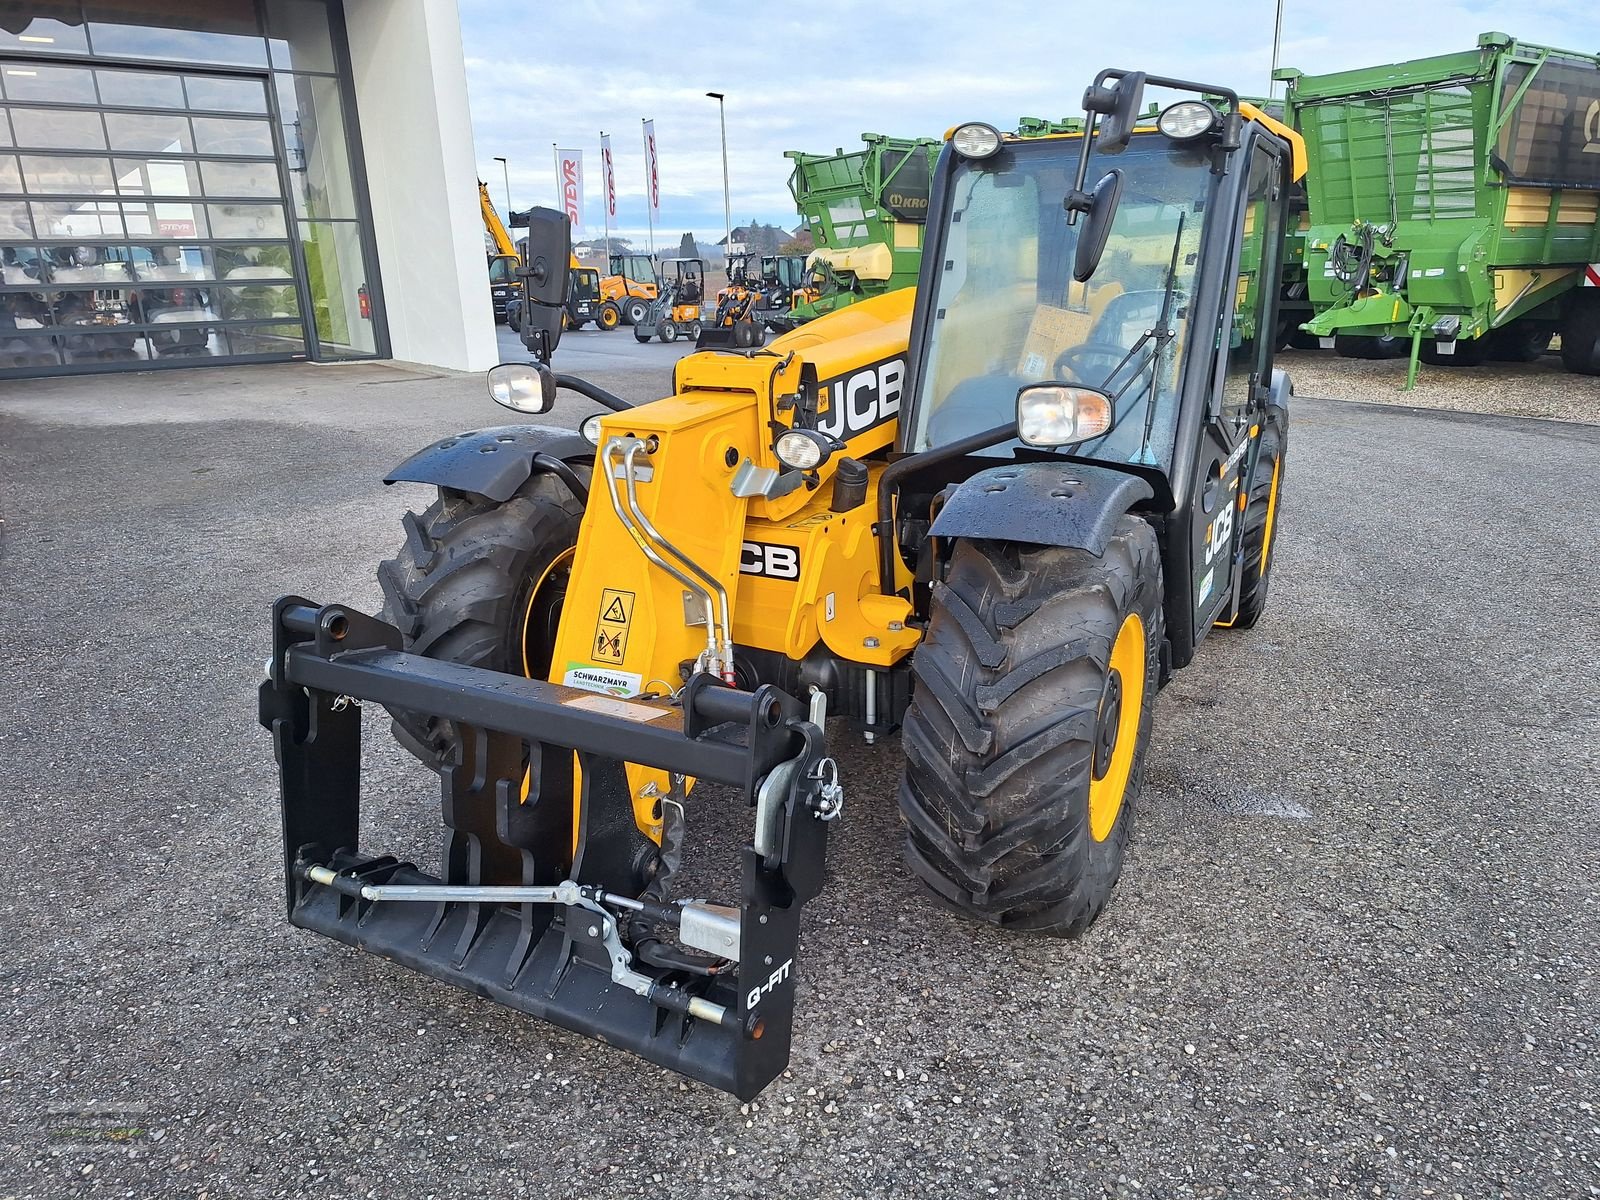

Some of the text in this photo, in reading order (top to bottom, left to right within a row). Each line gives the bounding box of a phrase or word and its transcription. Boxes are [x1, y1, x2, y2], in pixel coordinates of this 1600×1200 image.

[563, 159, 578, 225] STEYR
[160, 223, 190, 231] STEYR
[818, 360, 906, 443] JCB
[1206, 500, 1234, 566] JCB
[573, 671, 628, 688] SCHWARZMAYR
